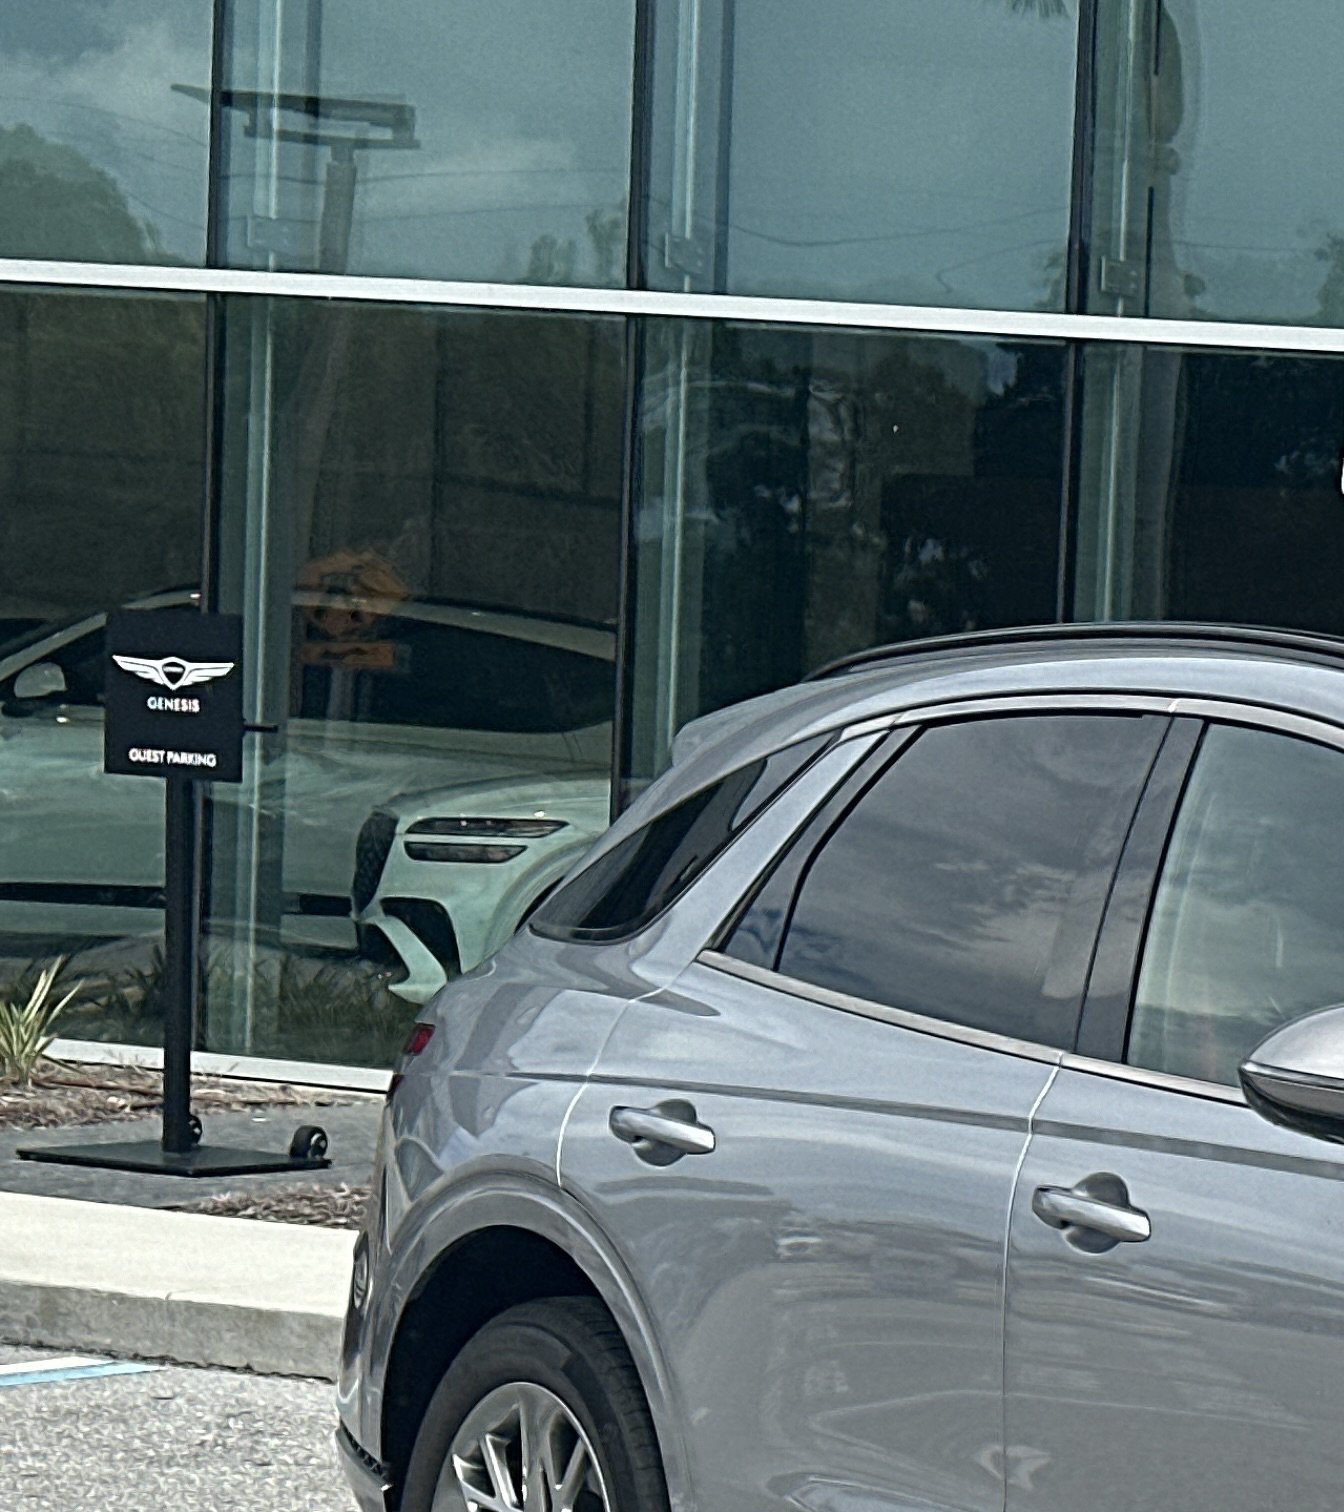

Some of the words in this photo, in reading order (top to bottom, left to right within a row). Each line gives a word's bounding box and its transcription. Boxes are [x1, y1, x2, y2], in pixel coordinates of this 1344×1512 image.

[147, 696, 200, 713] GENESIS
[128, 747, 165, 764] GUEST
[166, 750, 217, 768] PARKING
